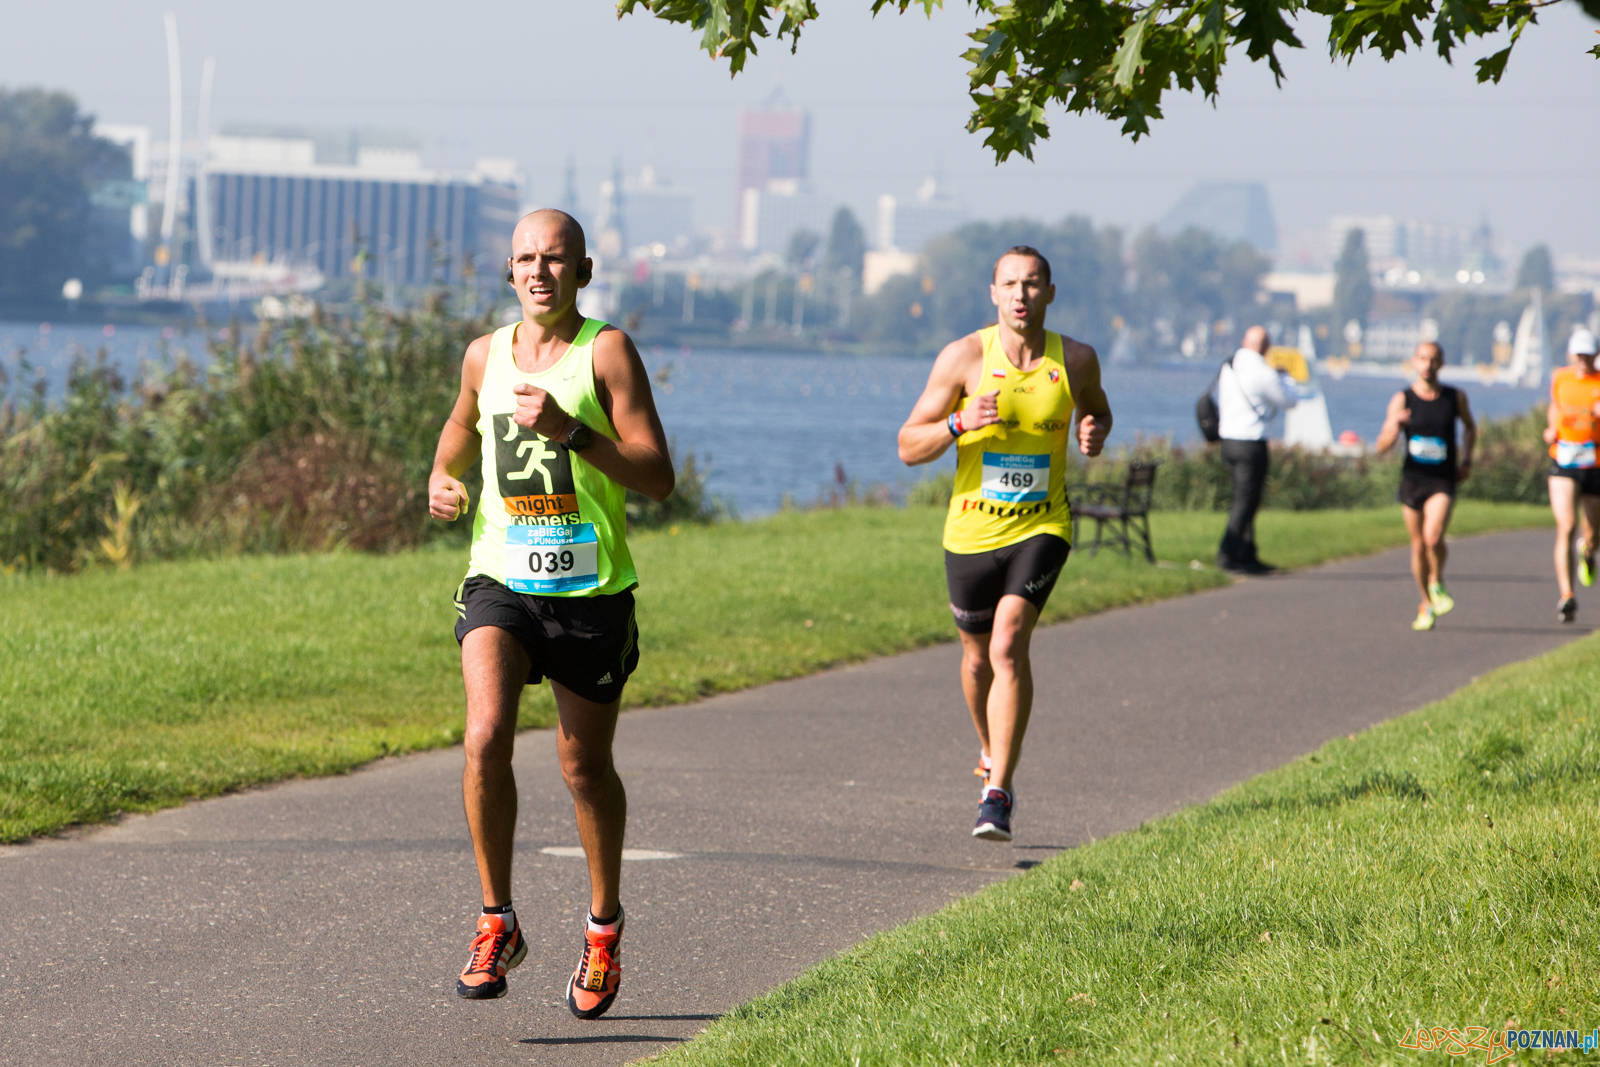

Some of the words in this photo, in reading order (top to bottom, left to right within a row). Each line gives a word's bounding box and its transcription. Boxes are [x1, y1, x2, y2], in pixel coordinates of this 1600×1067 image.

[999, 472, 1034, 488] 469
[515, 495, 564, 514] night
[511, 512, 580, 526] runners
[527, 526, 573, 537] zaBIEGaj
[528, 550, 575, 573] 039
